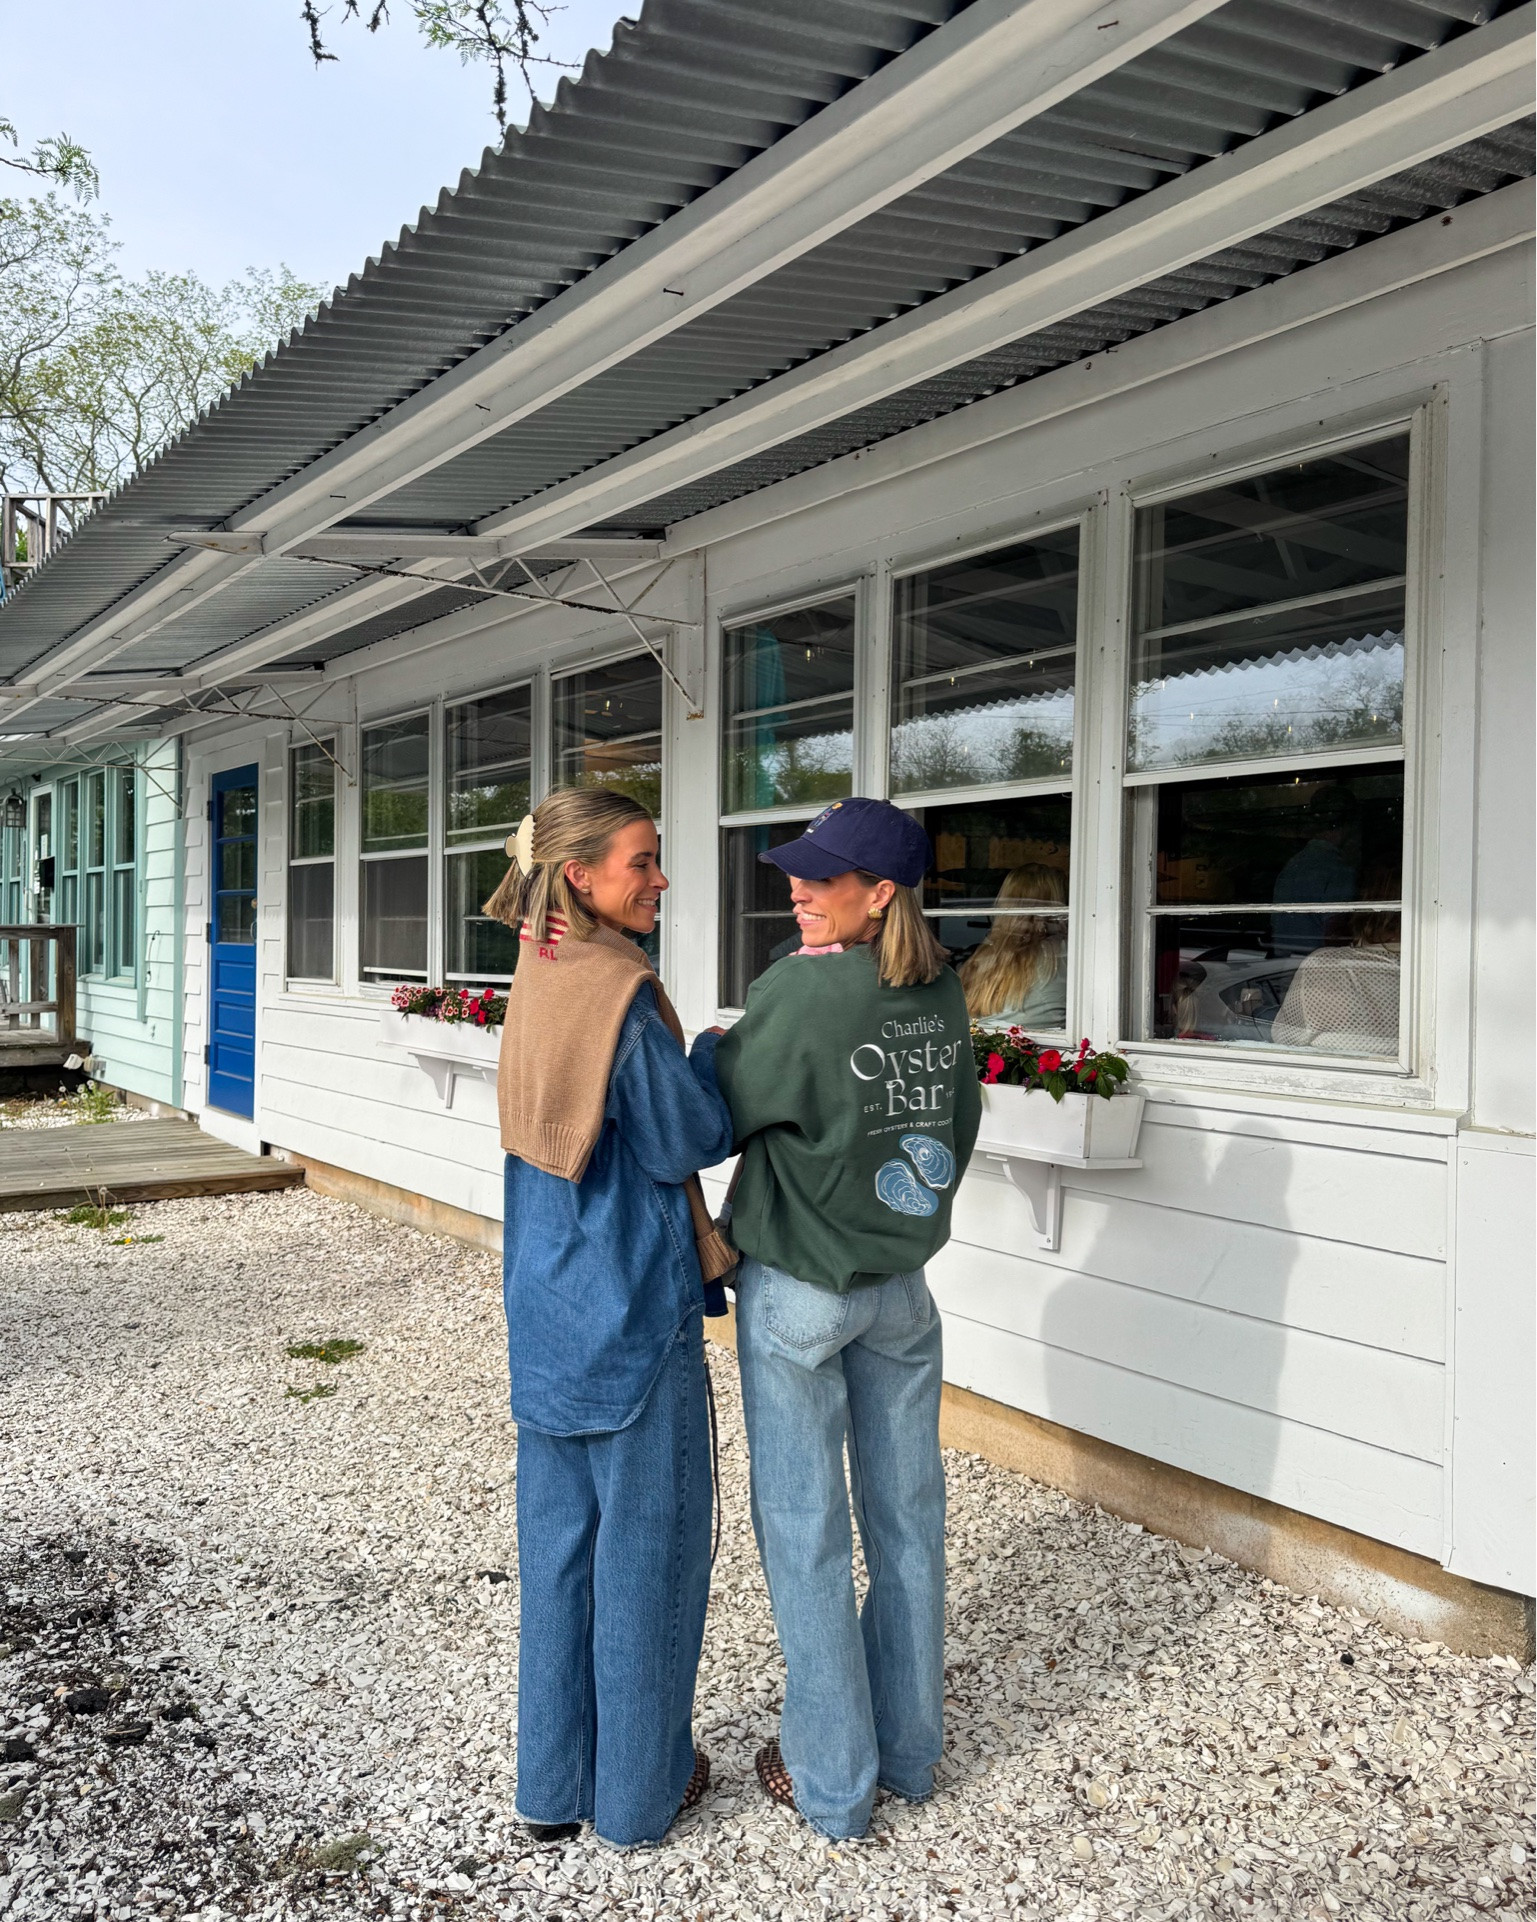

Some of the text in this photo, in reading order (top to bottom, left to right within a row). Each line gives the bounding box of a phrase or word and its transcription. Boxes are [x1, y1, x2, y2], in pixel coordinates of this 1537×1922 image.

[539, 946, 558, 961] RL
[881, 1014, 945, 1039] Charlie's
[850, 1040, 962, 1088] Oyster
[885, 1079, 944, 1116] Bar
[863, 1103, 883, 1113] EST.
[915, 1120, 936, 1128] CRAFT
